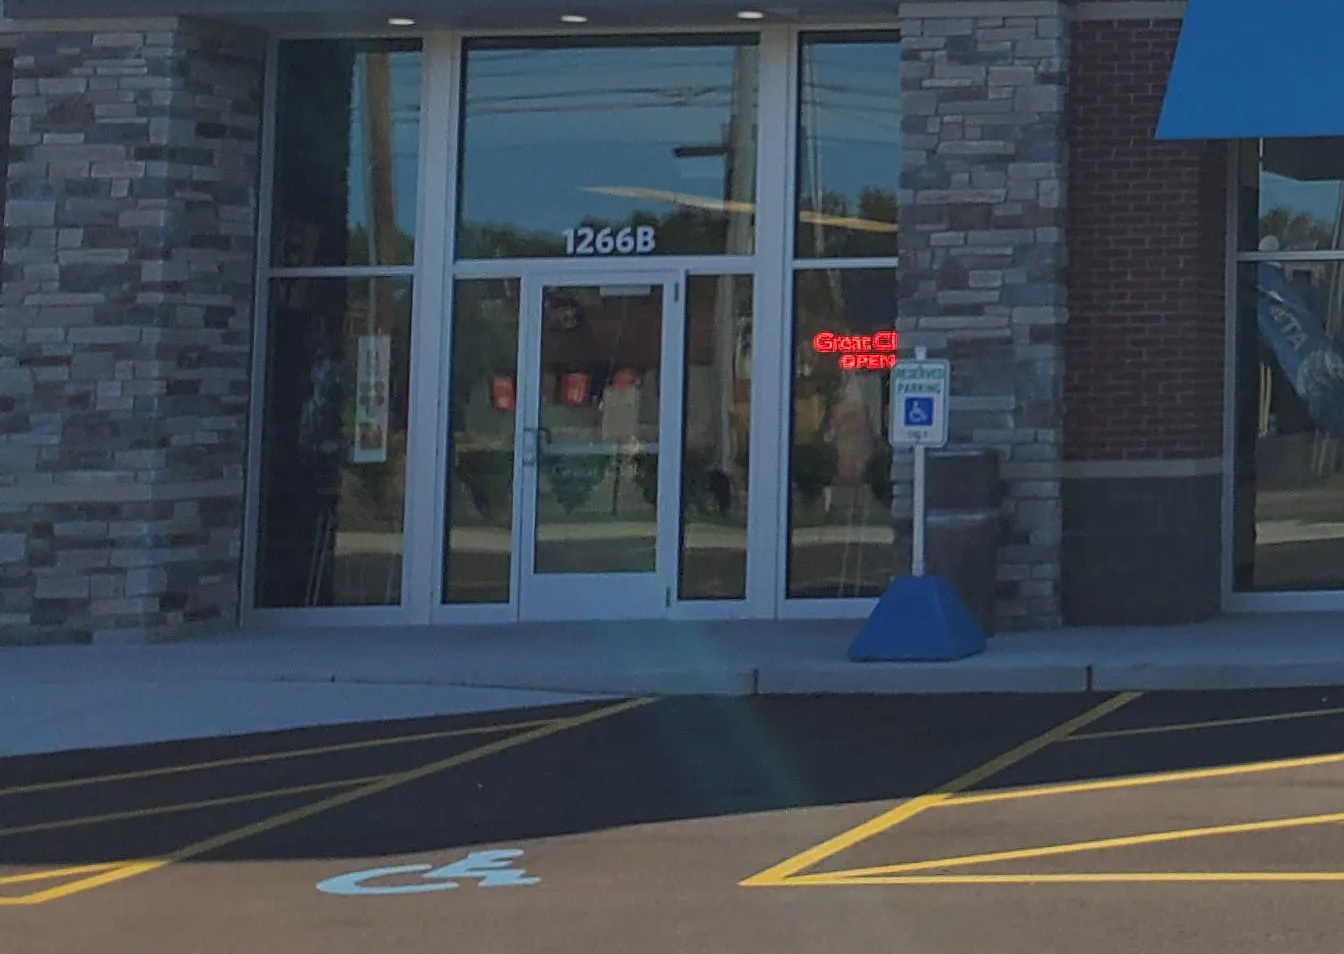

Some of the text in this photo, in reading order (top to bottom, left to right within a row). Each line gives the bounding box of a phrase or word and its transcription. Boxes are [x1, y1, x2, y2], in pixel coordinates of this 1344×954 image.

[563, 225, 656, 255] 1266B
[872, 330, 898, 352] Cl
[838, 354, 897, 370] OPEN
